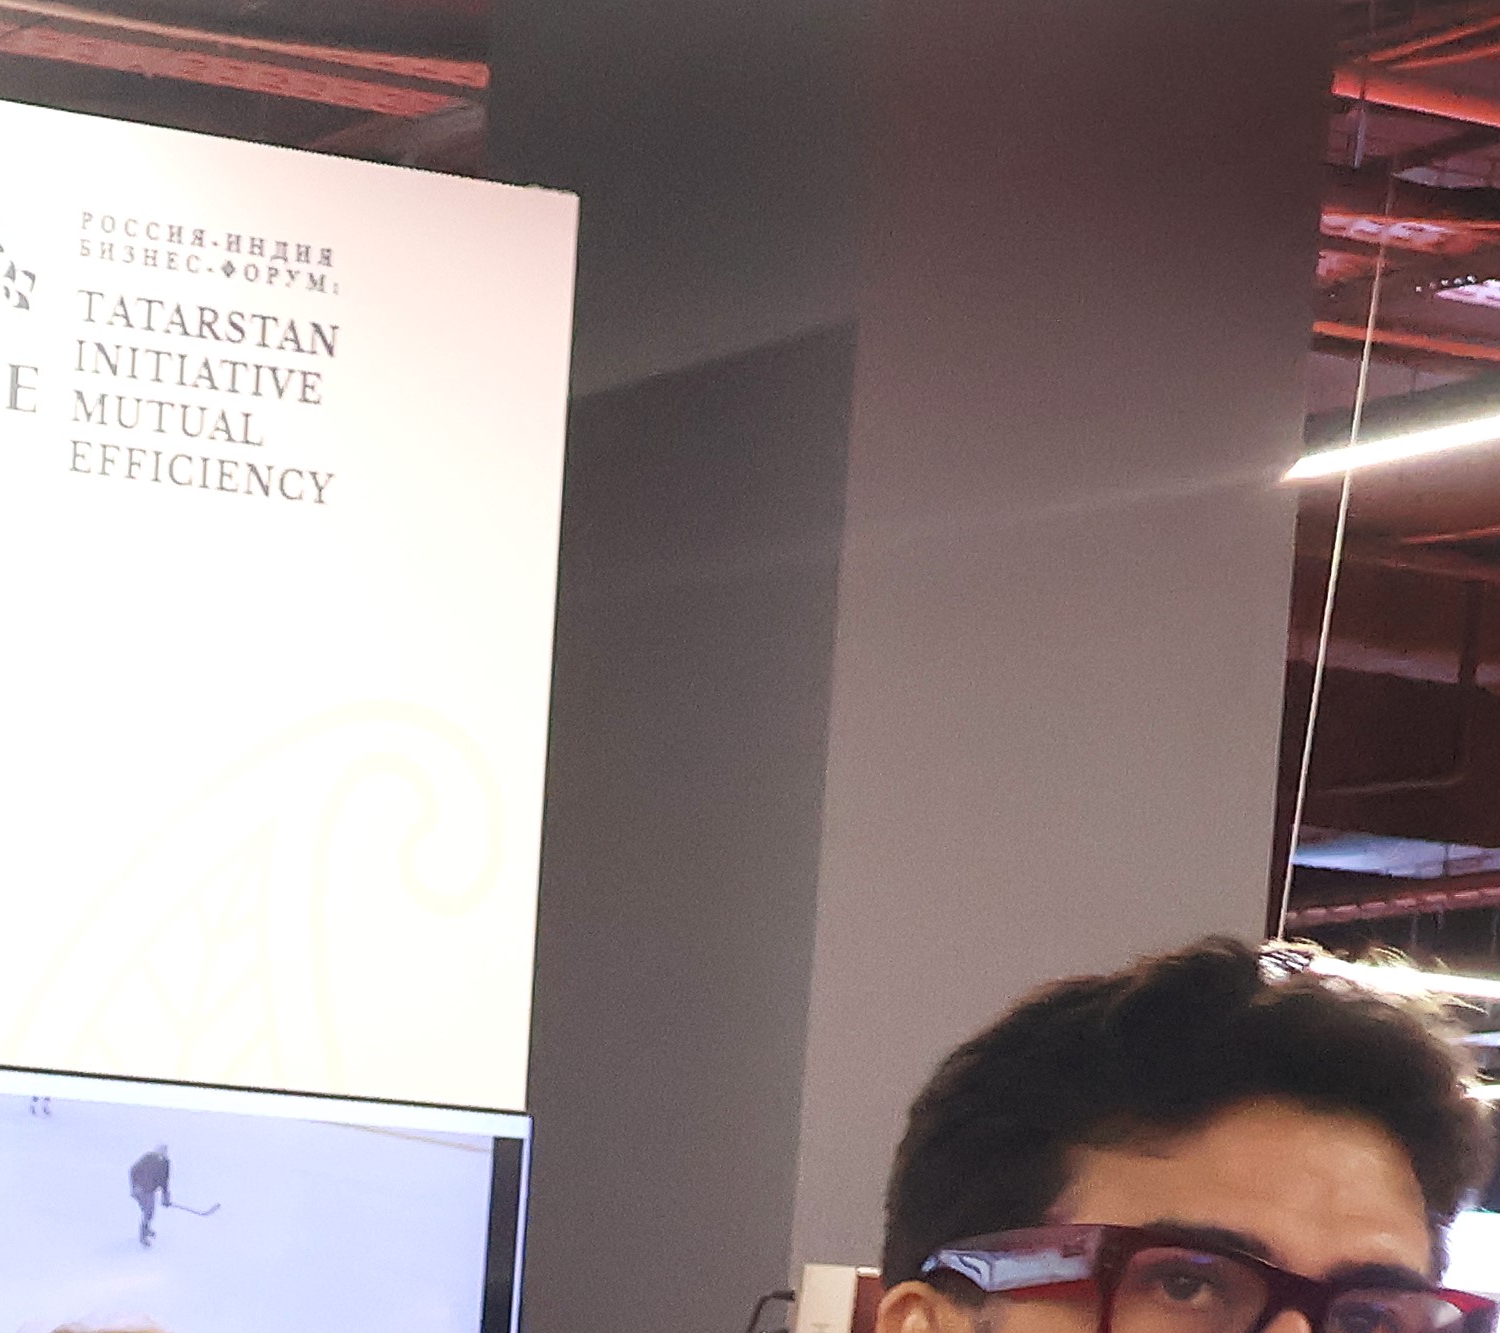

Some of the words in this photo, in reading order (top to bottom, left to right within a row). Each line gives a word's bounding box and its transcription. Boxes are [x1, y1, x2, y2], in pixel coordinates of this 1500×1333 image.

[77, 290, 341, 359] TATARSTAN
[74, 338, 324, 406] INITIATIVE
[71, 389, 265, 448] MUTUAL
[68, 440, 338, 506] EFFICIENCY
